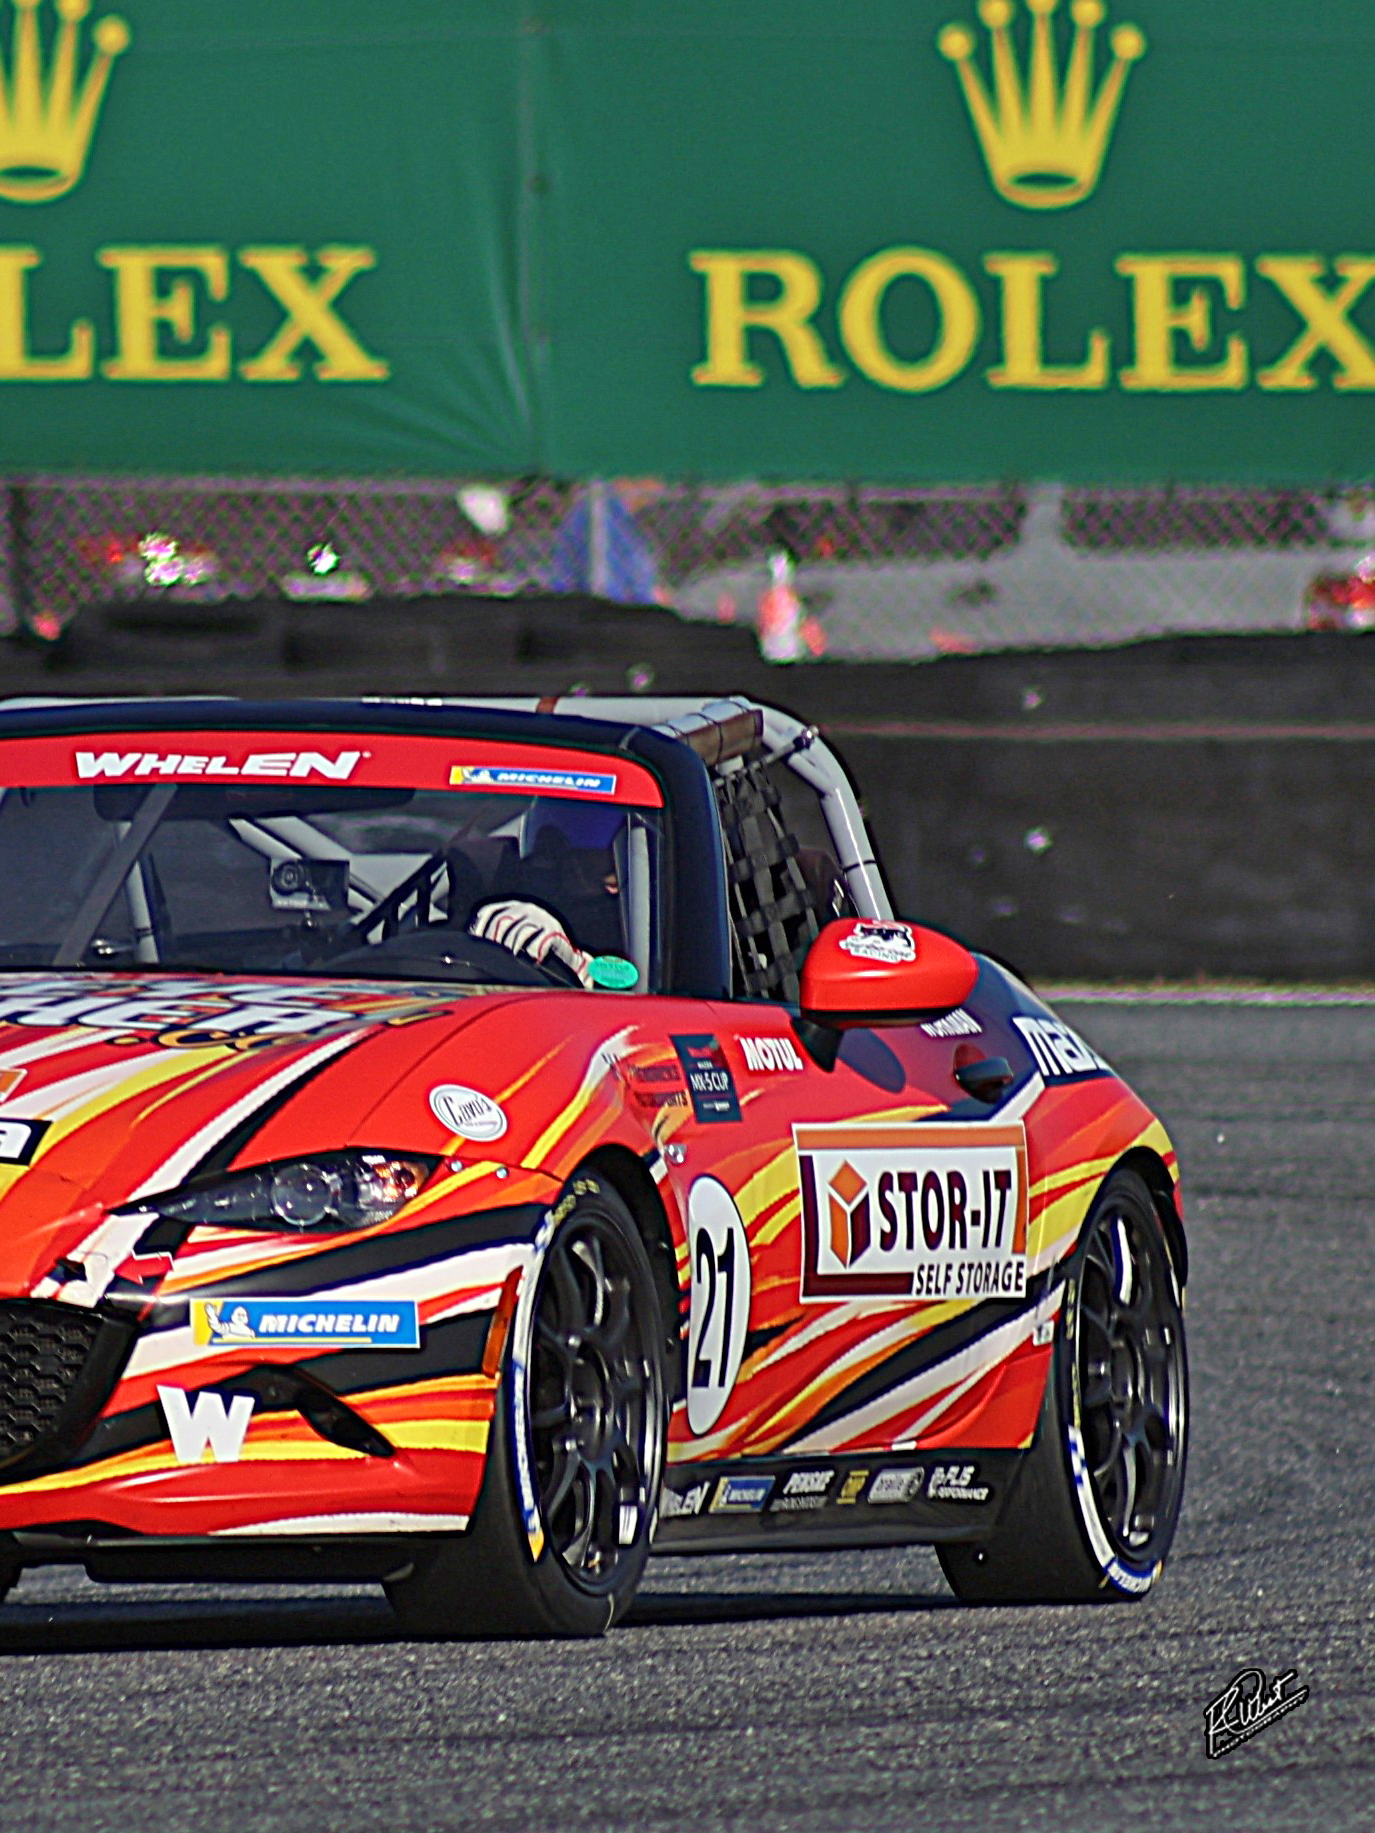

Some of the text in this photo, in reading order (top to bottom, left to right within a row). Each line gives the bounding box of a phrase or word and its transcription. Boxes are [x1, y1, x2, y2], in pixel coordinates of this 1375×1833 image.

[689, 246, 1375, 391] ROLEX
[75, 750, 362, 781] WHELEN
[496, 772, 601, 788] MICHELIN
[739, 1037, 804, 1072] MOTUL
[712, 1072, 730, 1091] CUP
[878, 1168, 1013, 1256] STOR-IT
[914, 1260, 1025, 1297] SELF STORAGE
[258, 1313, 401, 1334] MICHELIN
[692, 1227, 735, 1389] 21
[156, 1385, 256, 1463] W
